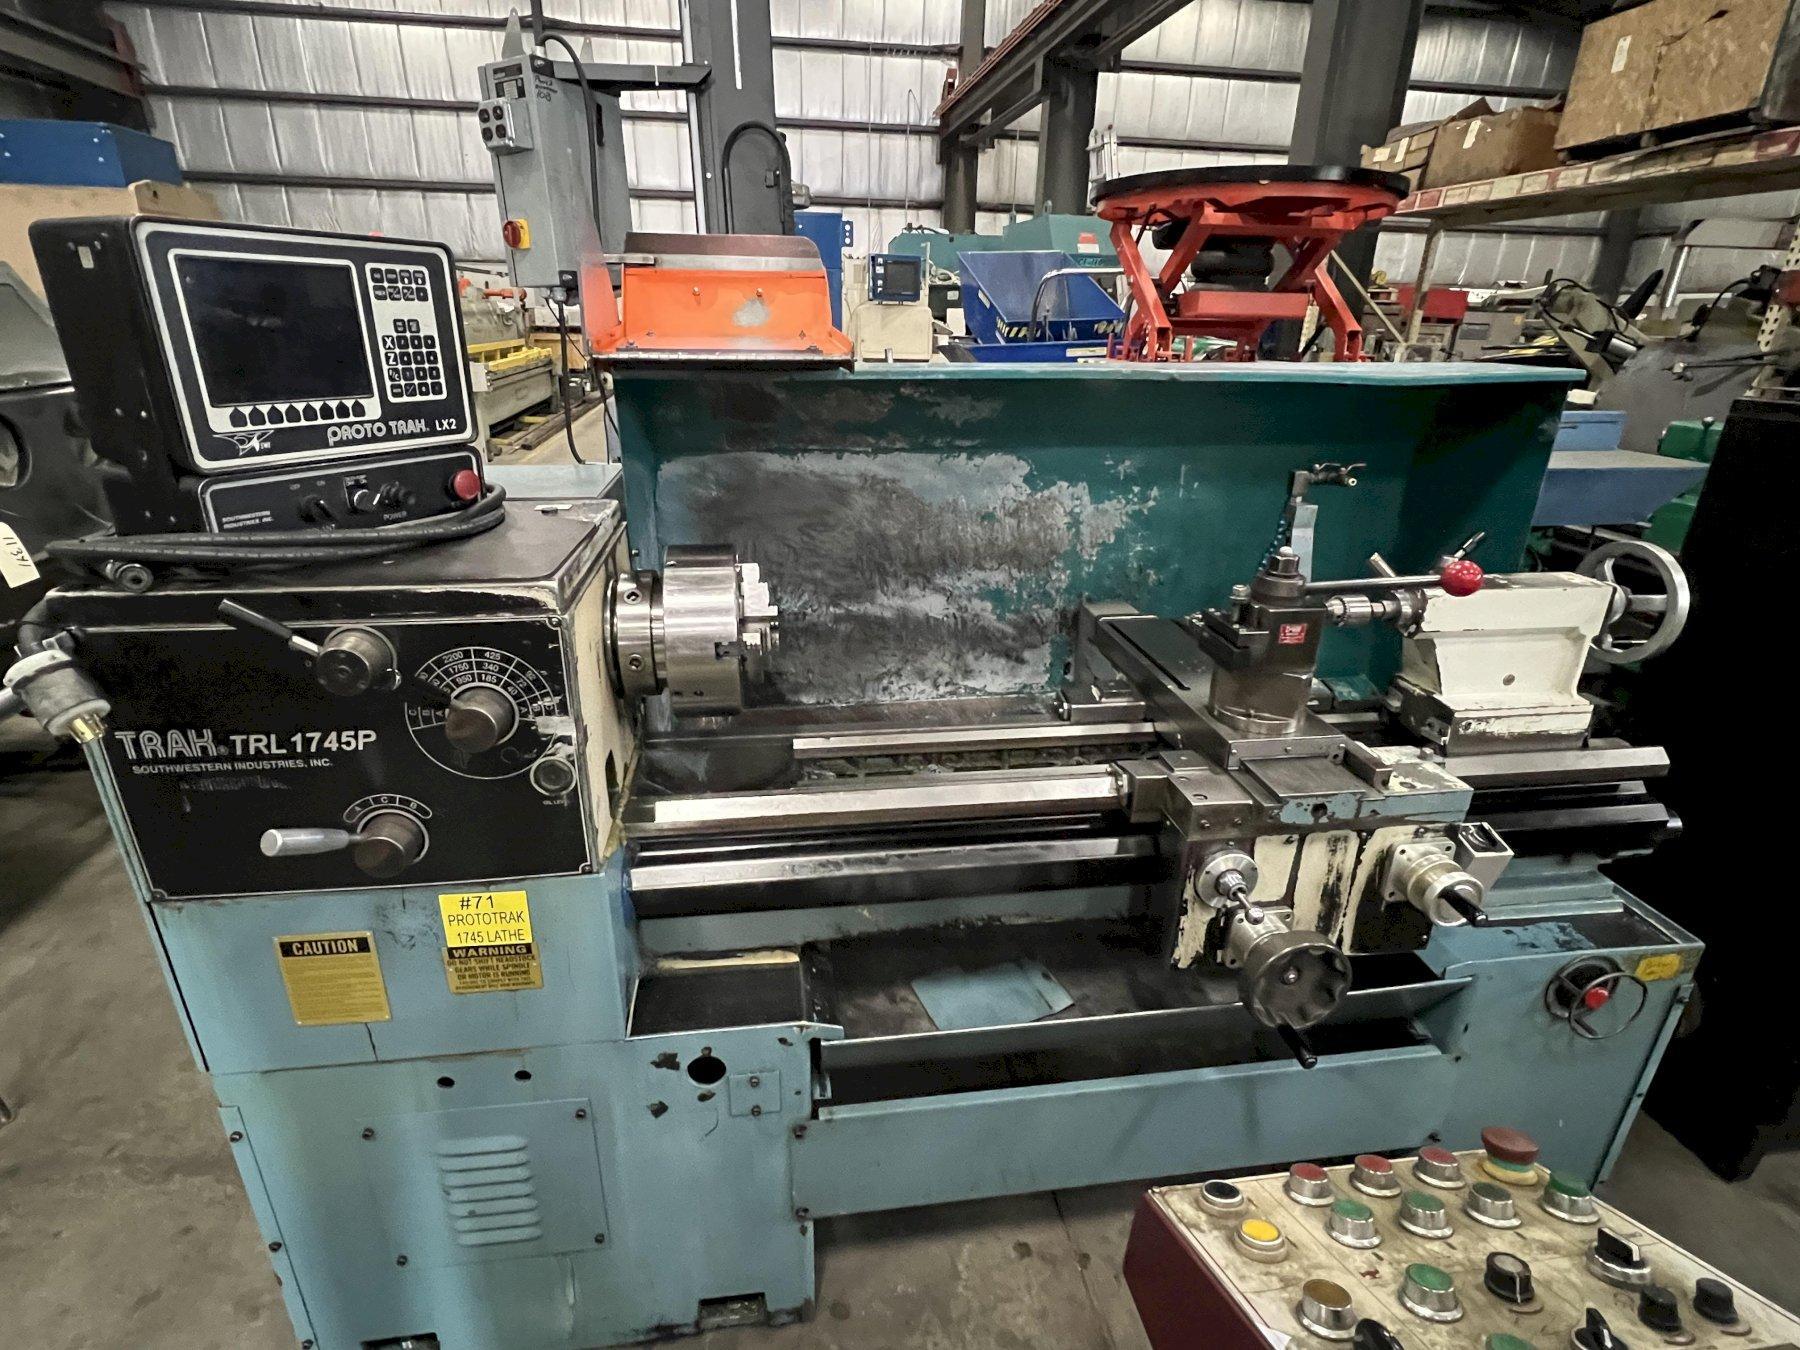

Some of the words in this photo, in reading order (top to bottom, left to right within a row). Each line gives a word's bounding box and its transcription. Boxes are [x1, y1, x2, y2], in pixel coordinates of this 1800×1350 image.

[384, 337, 394, 348] X
[387, 353, 397, 365] Z
[435, 418, 457, 431] LX2
[442, 651, 464, 663] 2200
[484, 651, 501, 660] 425
[449, 662, 470, 674] 1750
[482, 662, 499, 672] 340
[456, 674, 473, 685] 950
[481, 673, 497, 683] 185
[507, 686, 518, 696] 40
[229, 734, 287, 756] TRL
[290, 729, 378, 752] 1745P
[132, 761, 232, 775] SOUTHWESTERN
[310, 757, 333, 767] INC.
[459, 894, 495, 910] #71
[447, 910, 525, 927] PROTOTRAK
[457, 930, 484, 944] 1745
[486, 928, 526, 943] LATHE
[292, 939, 359, 956] CAUTION
[452, 944, 527, 958] WARNING
[479, 963, 500, 972] WHILE
